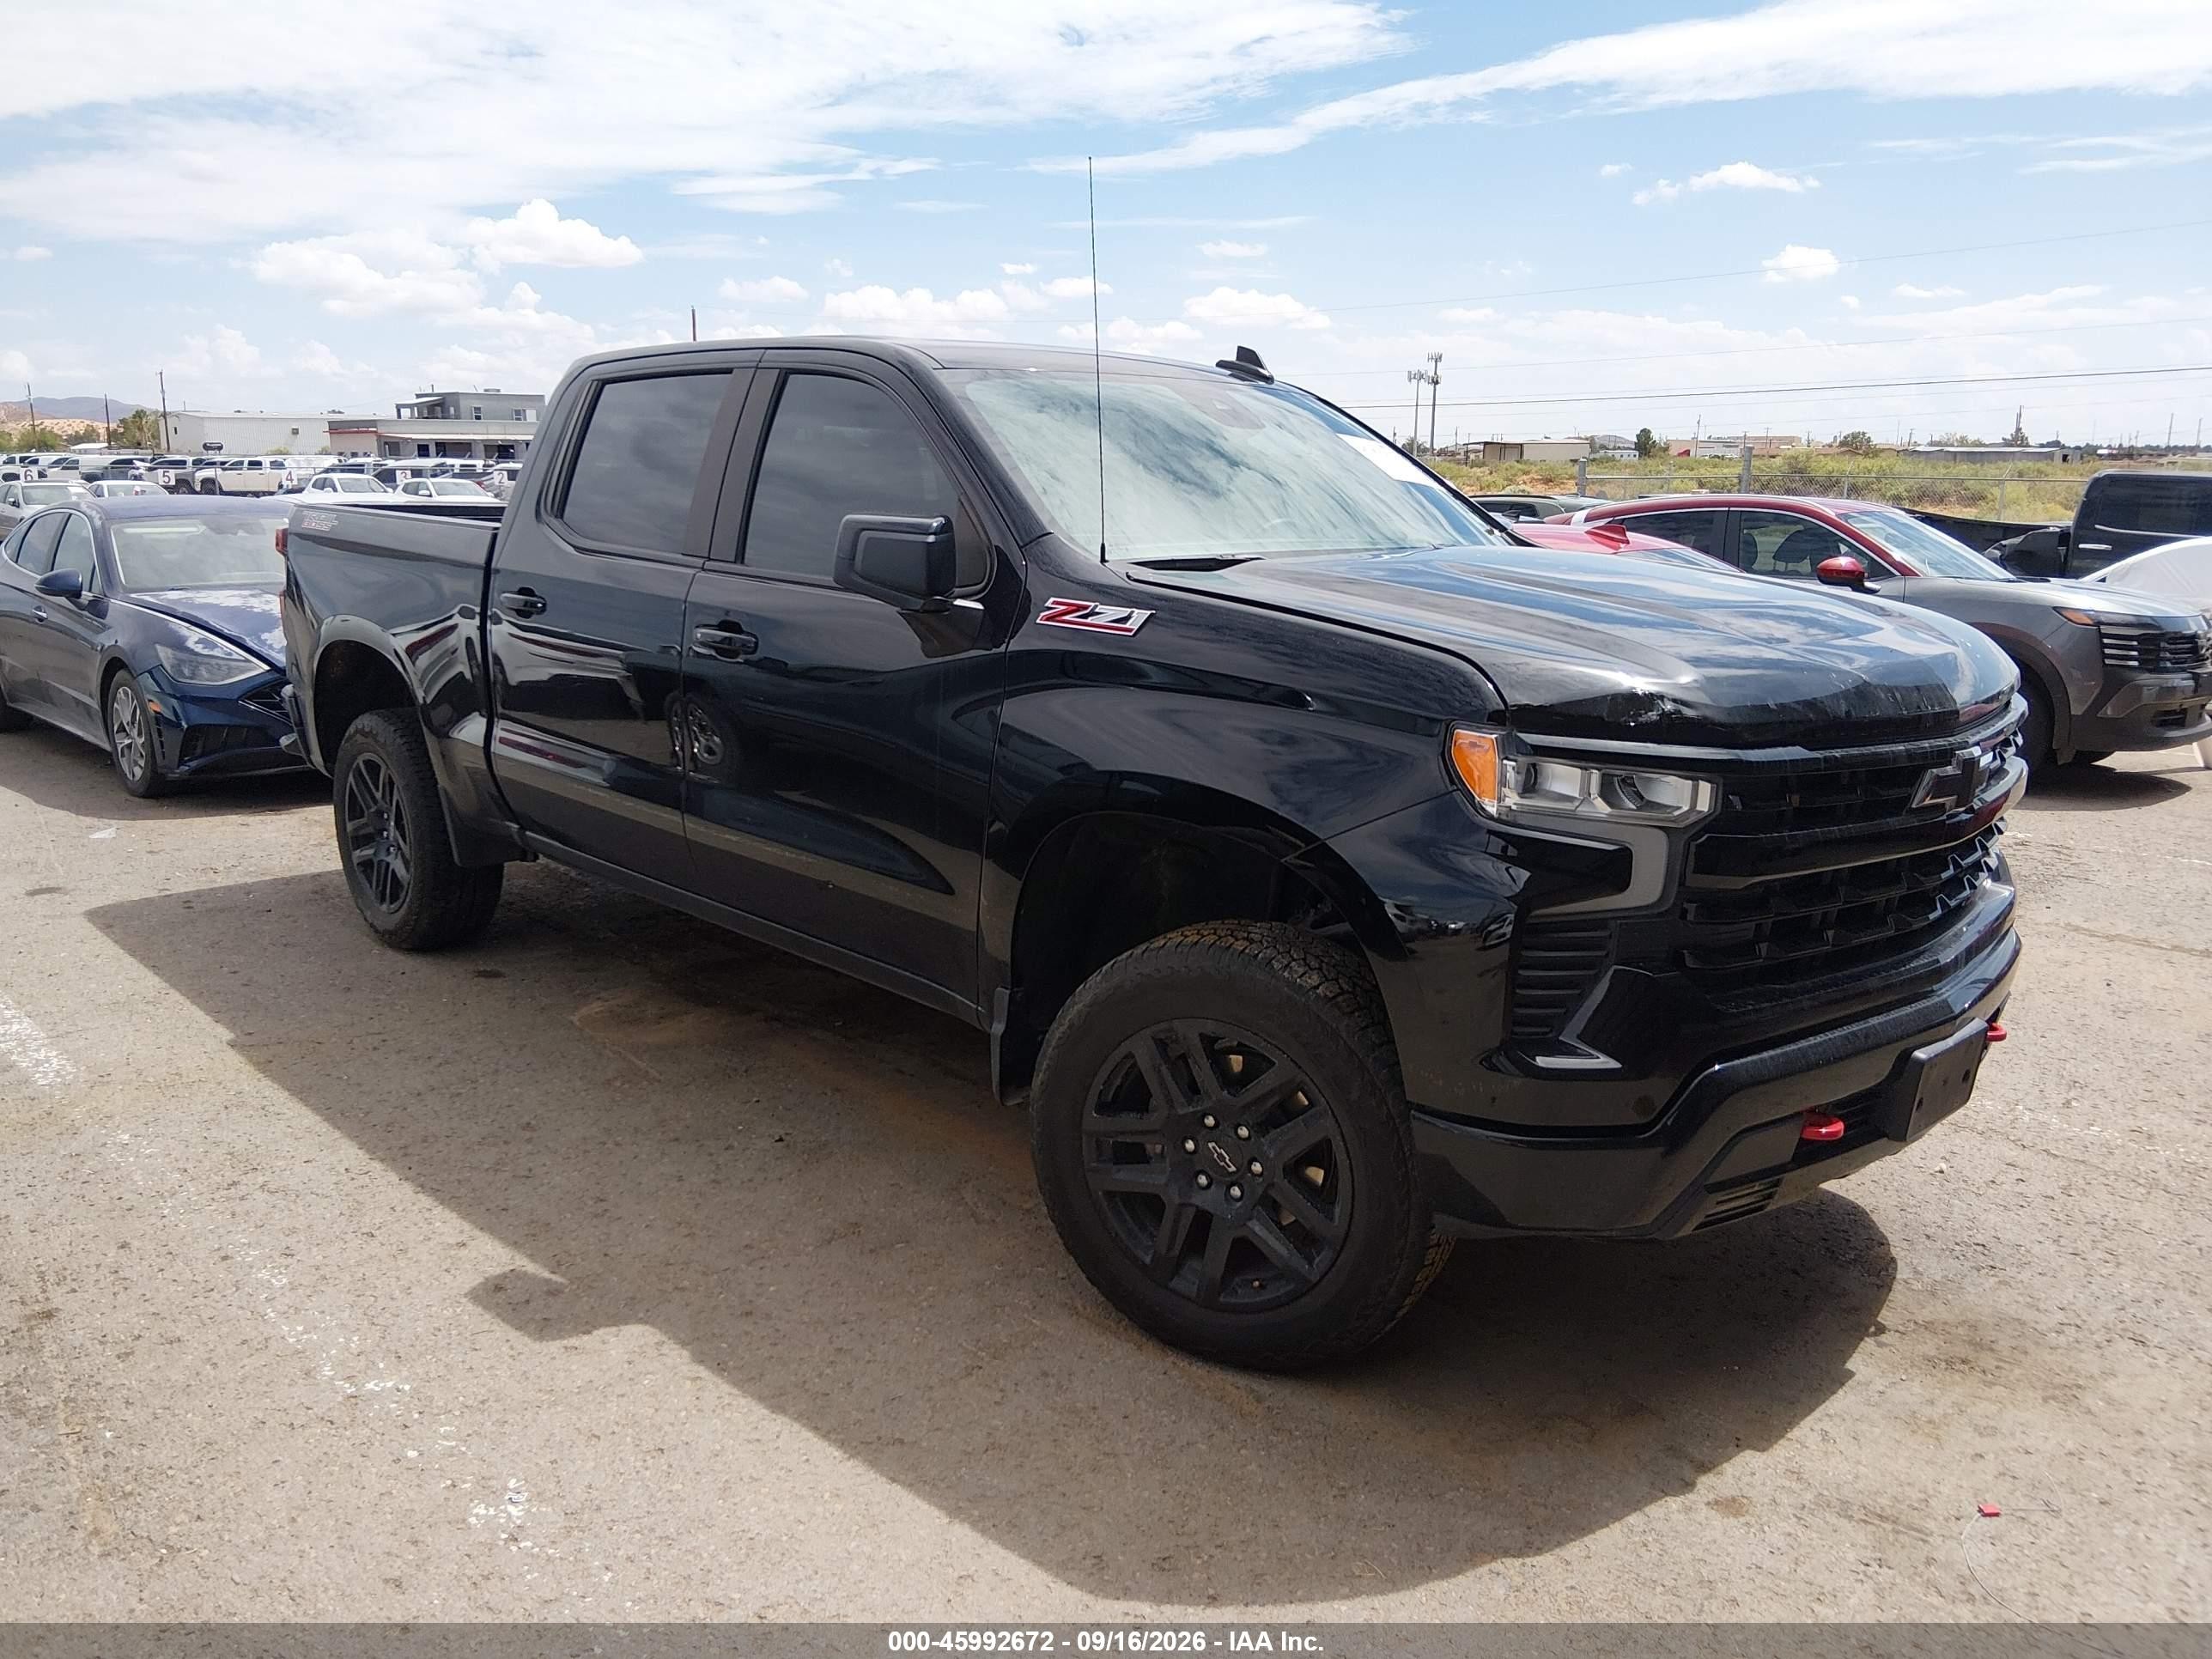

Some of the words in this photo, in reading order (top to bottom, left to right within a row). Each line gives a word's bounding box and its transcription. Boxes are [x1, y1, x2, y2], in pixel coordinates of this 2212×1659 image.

[162, 470, 171, 484] 5
[285, 470, 295, 483] 4
[497, 471, 506, 484] 2
[301, 520, 332, 532] BOSS
[1036, 596, 1156, 636] Z71
